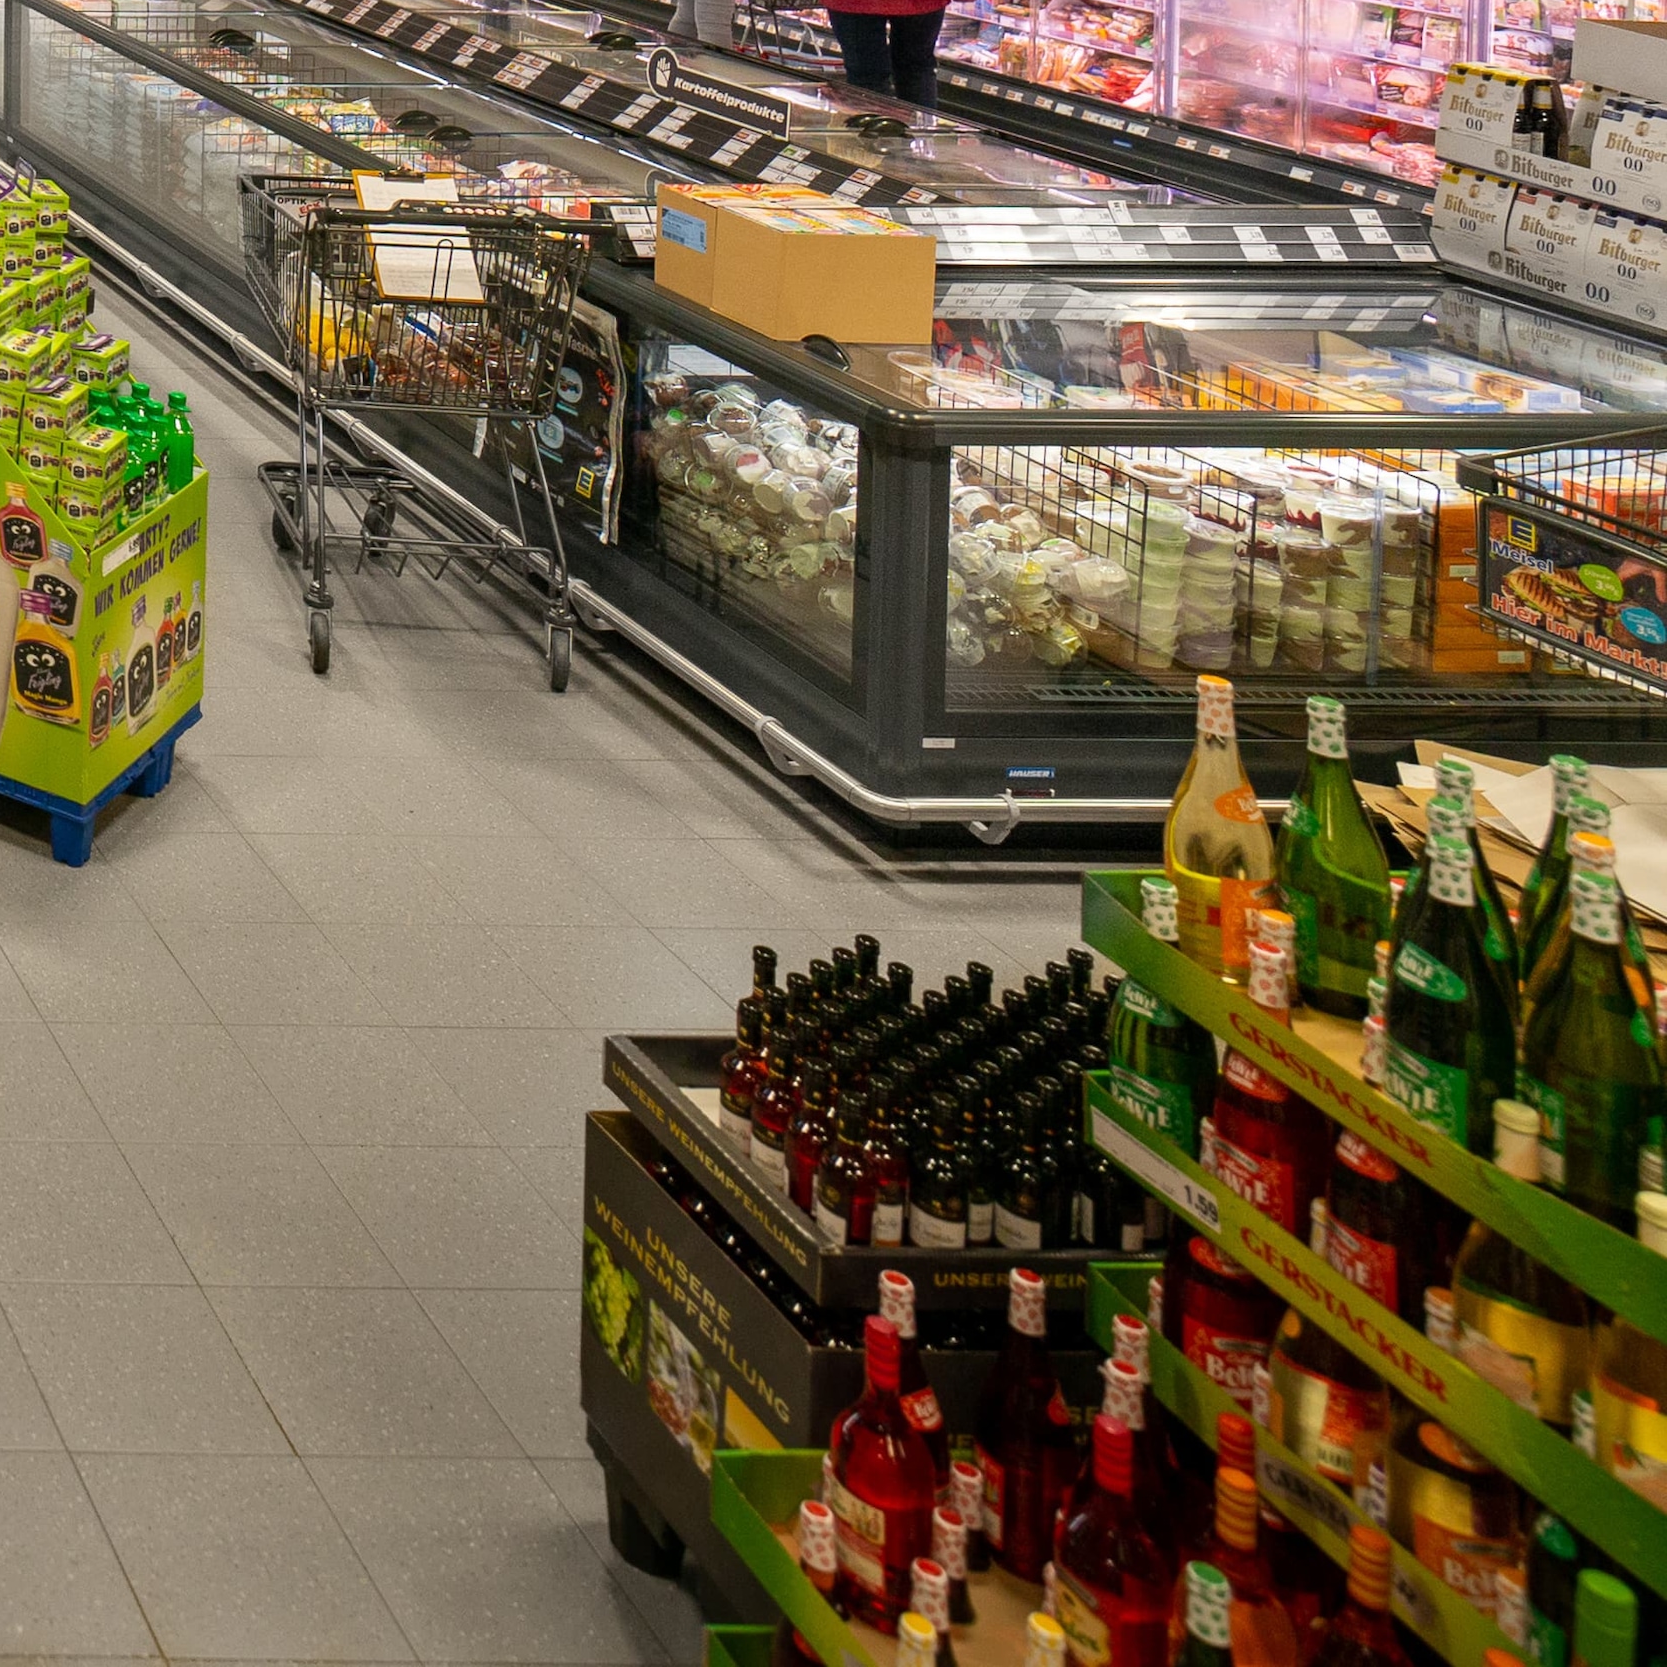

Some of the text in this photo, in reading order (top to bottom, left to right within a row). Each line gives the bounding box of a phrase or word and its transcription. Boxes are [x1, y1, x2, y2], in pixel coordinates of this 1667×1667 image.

[674, 75, 785, 125] Kartoffelprodukte
[1448, 94, 1505, 124] Bitburger
[1604, 130, 1667, 163] Bitburger
[1511, 149, 1573, 189] Bitburger
[277, 196, 307, 206] OPTIK
[1443, 193, 1497, 225] Bitburger
[1519, 214, 1577, 248] Bitburger
[1504, 257, 1568, 294] Bitburger
[1597, 237, 1662, 275] Bitburger
[94, 517, 202, 618] WIR KOMMEN GERNE!
[1491, 539, 1555, 576] Meisel
[1493, 594, 1542, 628] Hier
[1544, 610, 1578, 644] im
[1008, 768, 1052, 778] HAUSER
[1228, 1012, 1434, 1168] GERSTACKER
[611, 1060, 808, 1268] UNSERE WEINEMPFEHLUNG
[1184, 1183, 1220, 1225] 1.59
[645, 1226, 732, 1330] UNSERE
[934, 1272, 1010, 1289] UNSER
[593, 1194, 791, 1426] WEINEMPFEHLUNG
[1238, 1226, 1449, 1403] GERSTACKER
